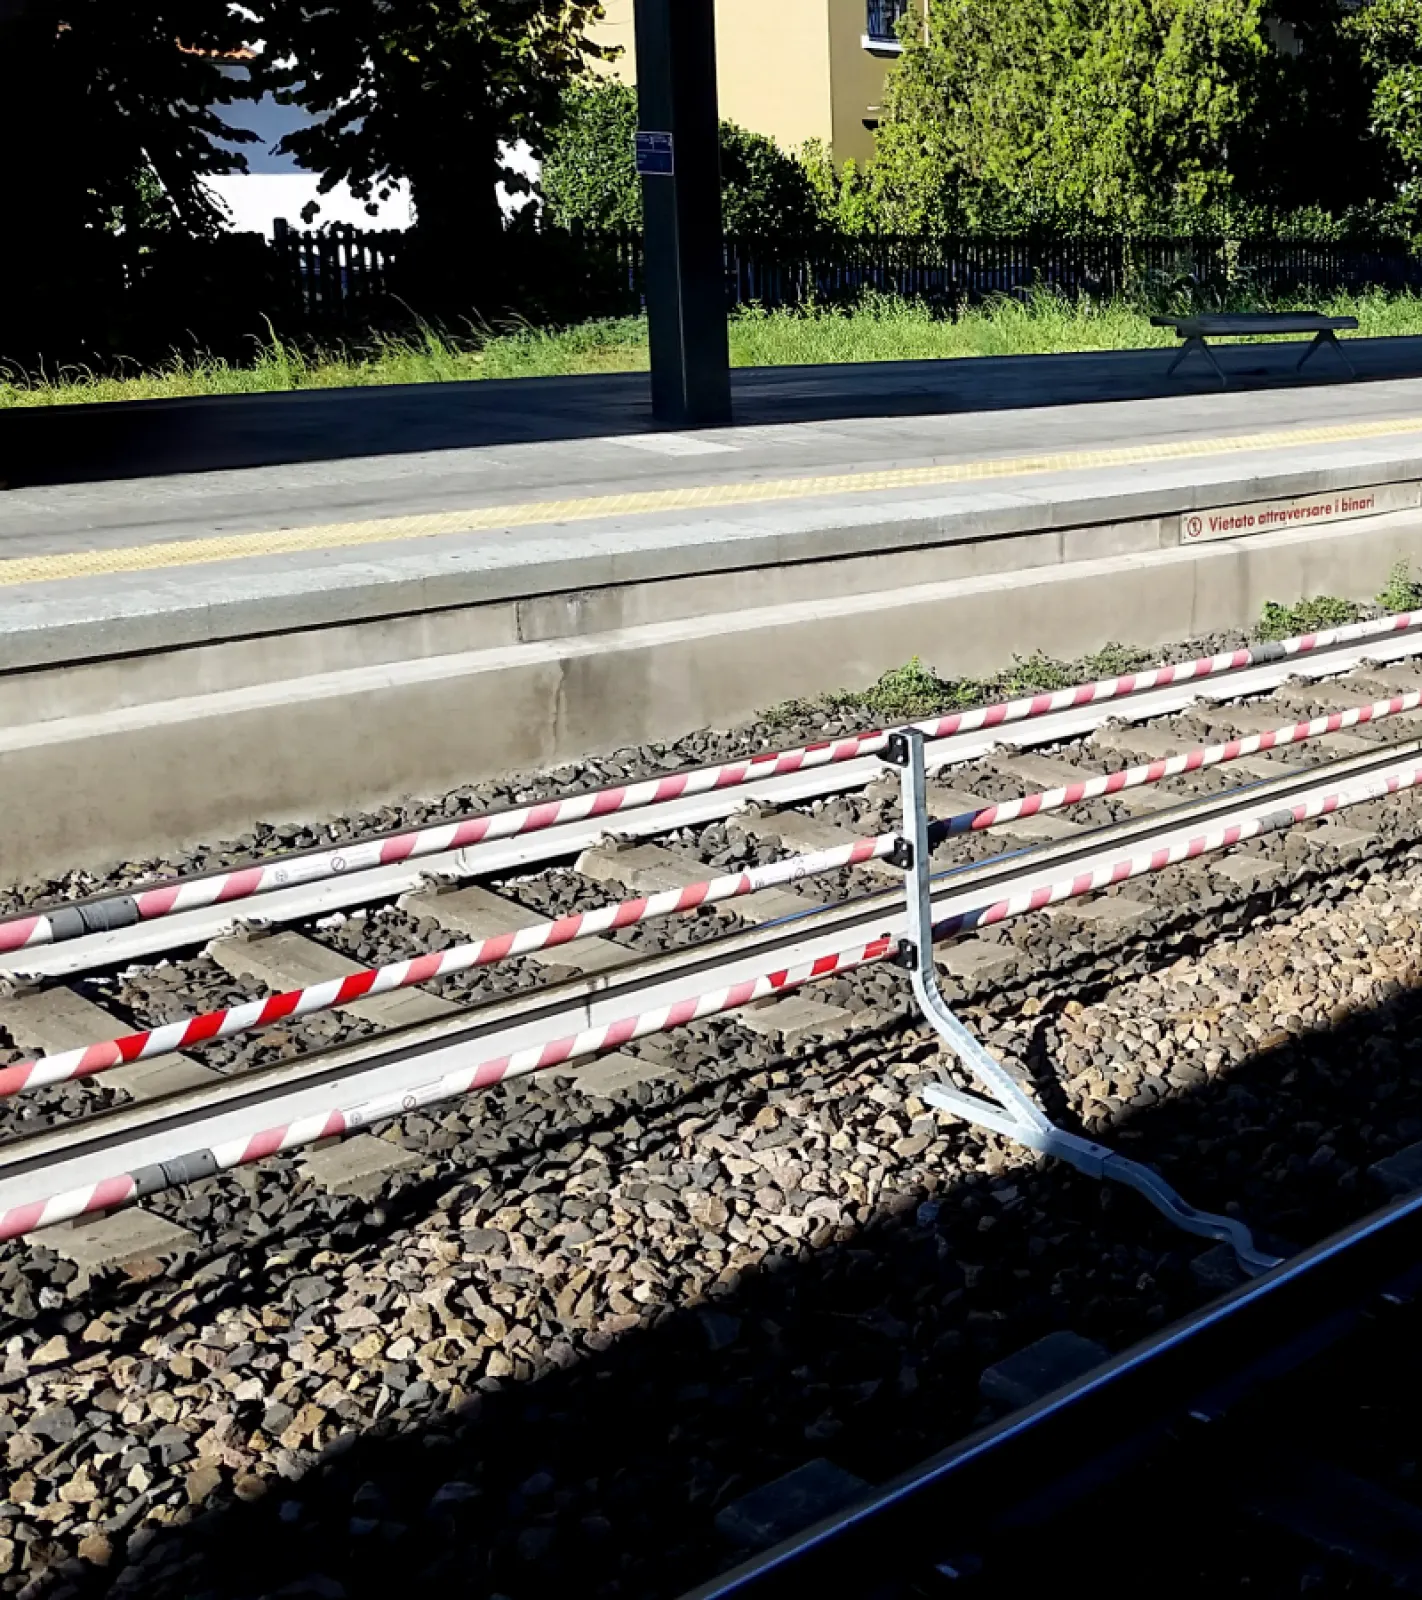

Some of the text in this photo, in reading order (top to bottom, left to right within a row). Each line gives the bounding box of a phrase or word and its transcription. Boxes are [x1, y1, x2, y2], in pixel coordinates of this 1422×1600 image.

[1209, 494, 1375, 532] Vietato attraversare i binari
